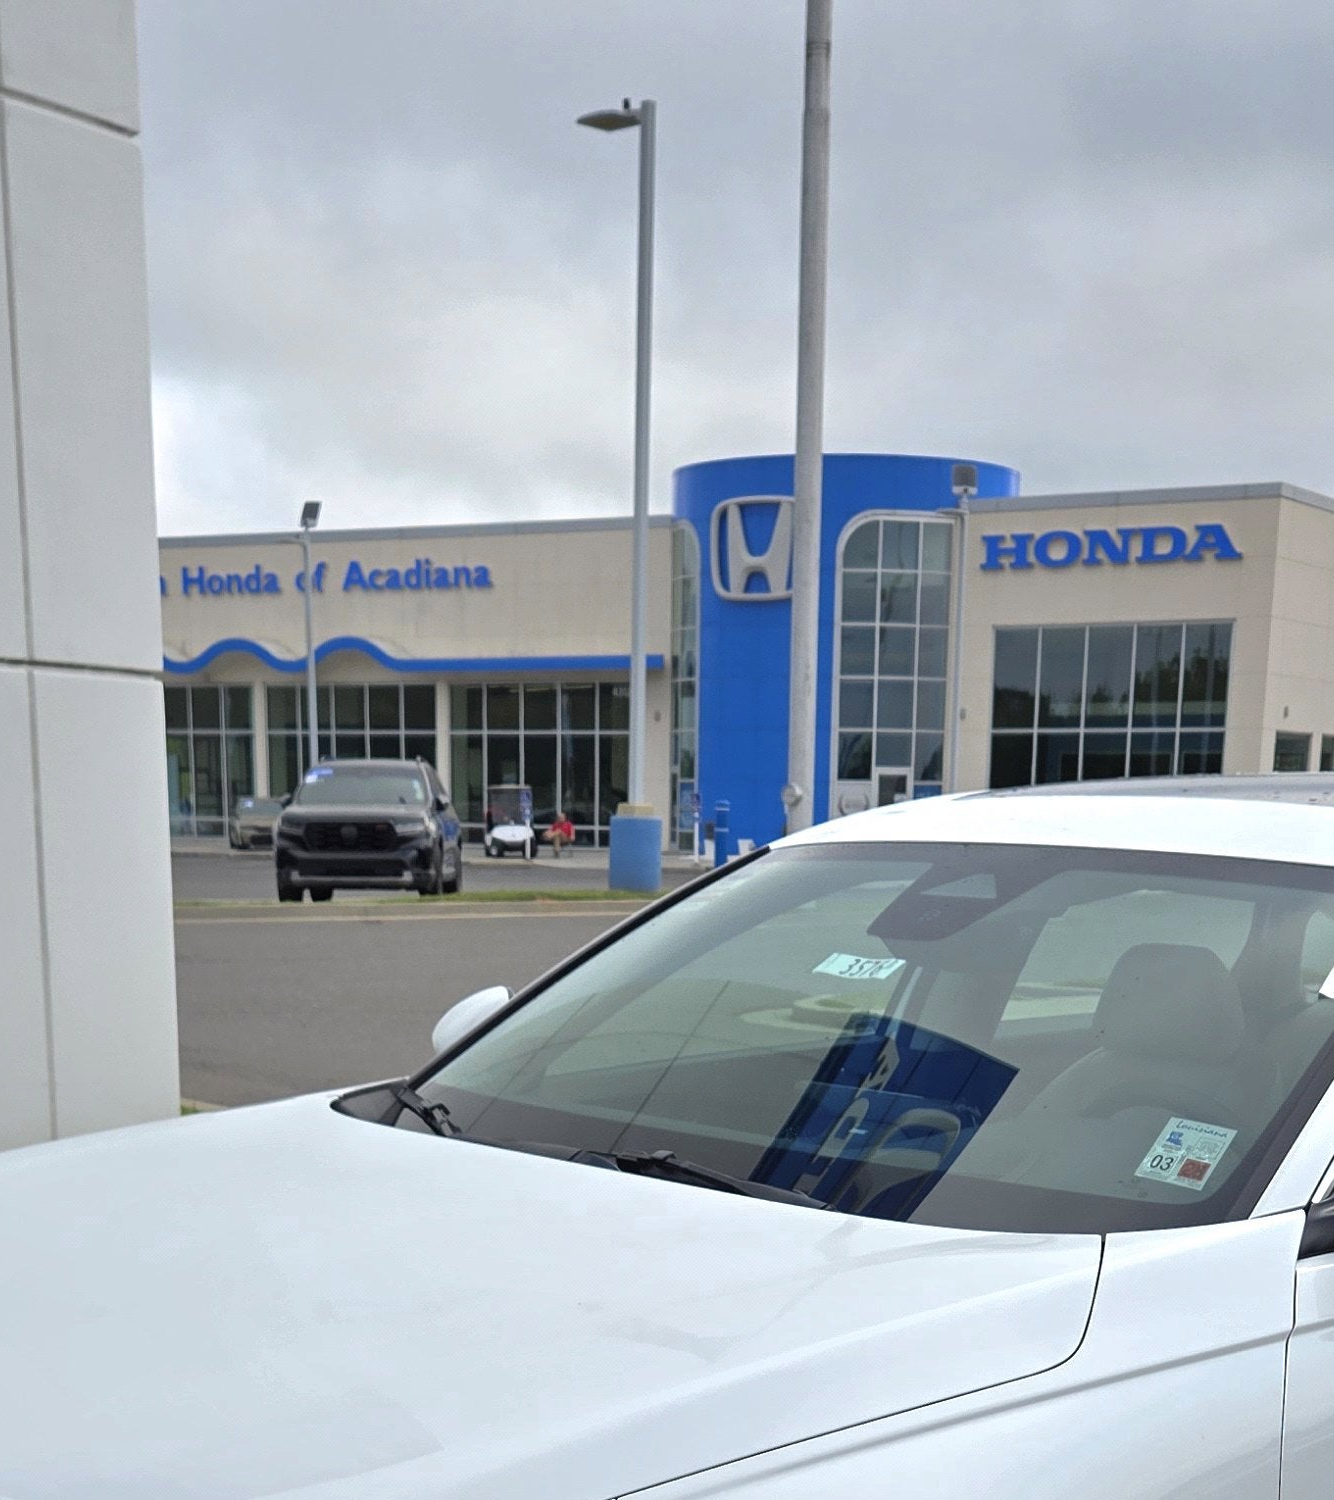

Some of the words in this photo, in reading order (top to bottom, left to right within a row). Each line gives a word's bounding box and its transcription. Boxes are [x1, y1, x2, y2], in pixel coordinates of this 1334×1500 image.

[980, 524, 1243, 571] HONDA
[181, 564, 280, 595] Honda
[295, 560, 326, 593] of
[342, 558, 492, 592] Acadiana
[1149, 1154, 1175, 1172] 03
